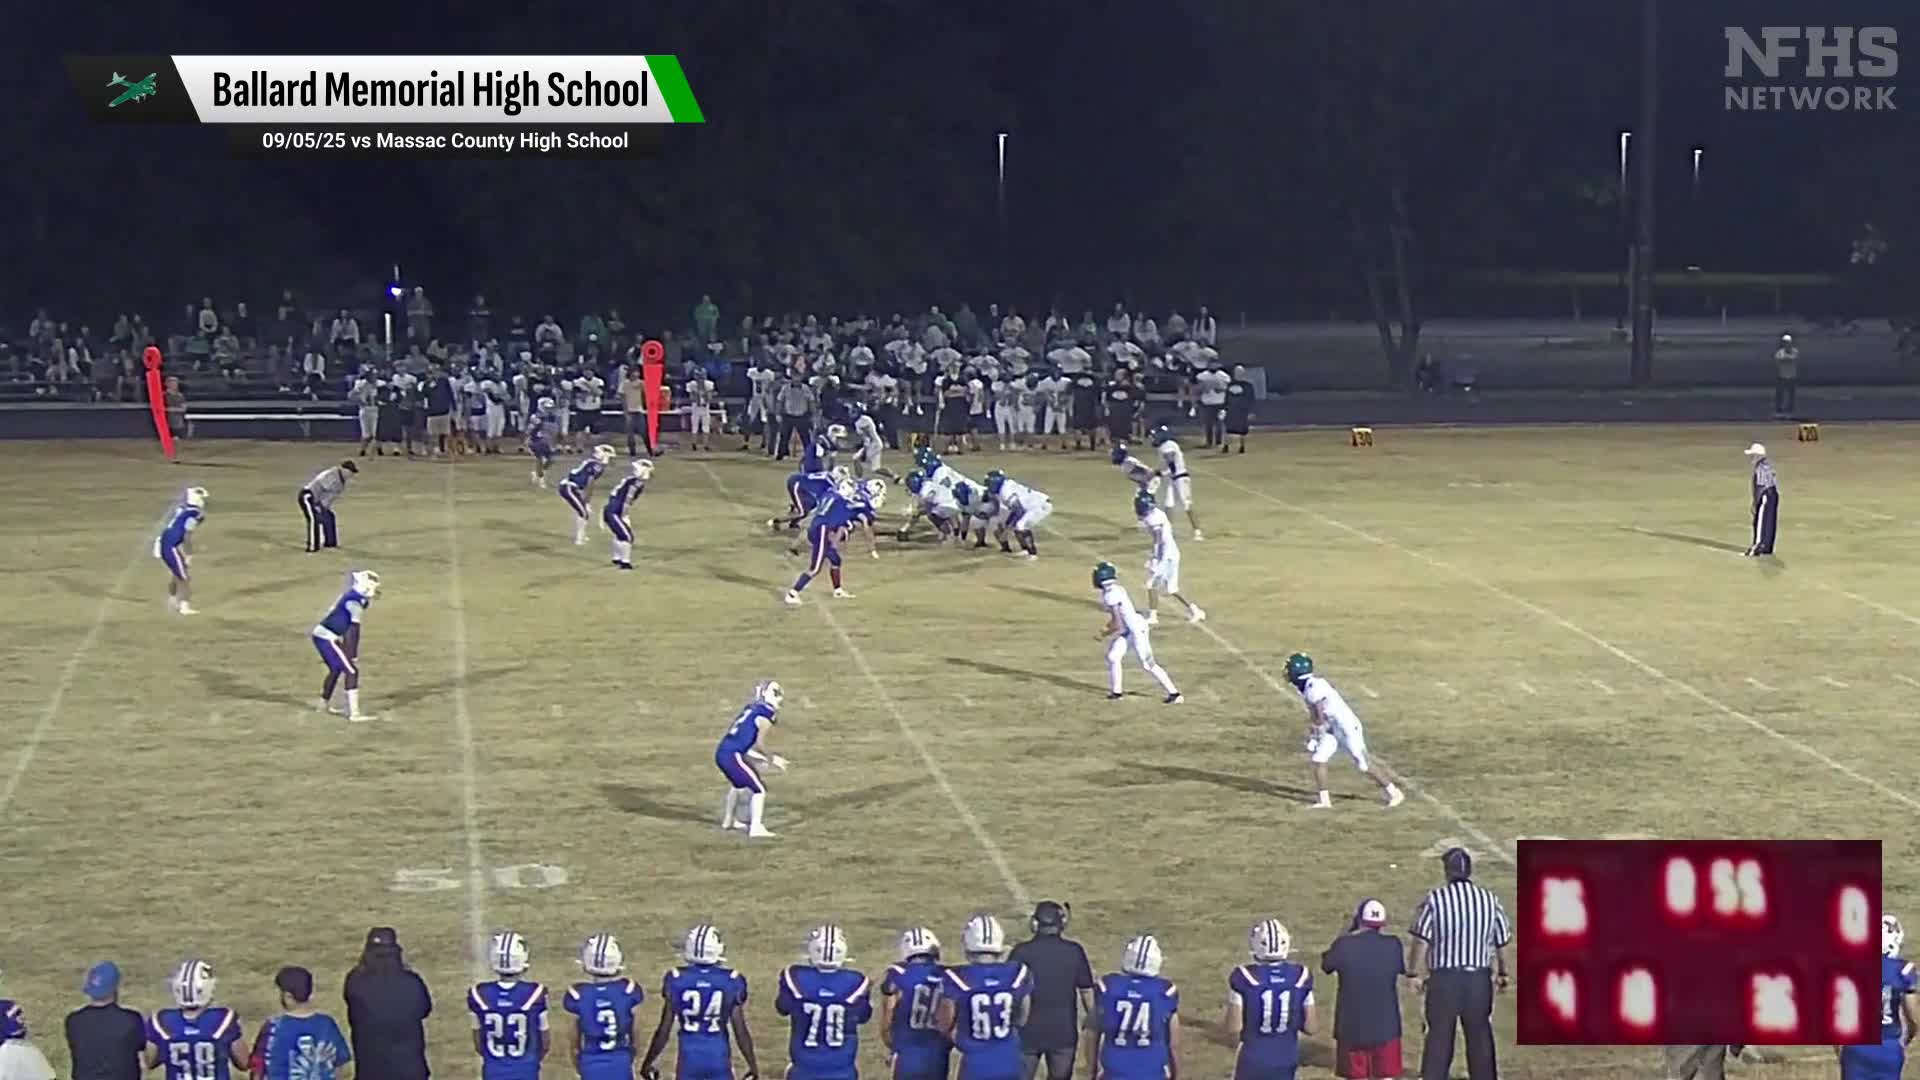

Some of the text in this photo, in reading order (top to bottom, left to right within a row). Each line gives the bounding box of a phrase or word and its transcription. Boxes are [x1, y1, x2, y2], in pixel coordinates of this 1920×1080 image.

[596, 1010, 617, 1050] 3
[682, 990, 722, 1032] 24
[804, 1003, 845, 1046] 70
[970, 992, 1013, 1040] 63
[1114, 1000, 1151, 1046] 74
[1259, 989, 1290, 1033] 11
[484, 1012, 528, 1057] 23
[168, 1041, 216, 1080] 58
